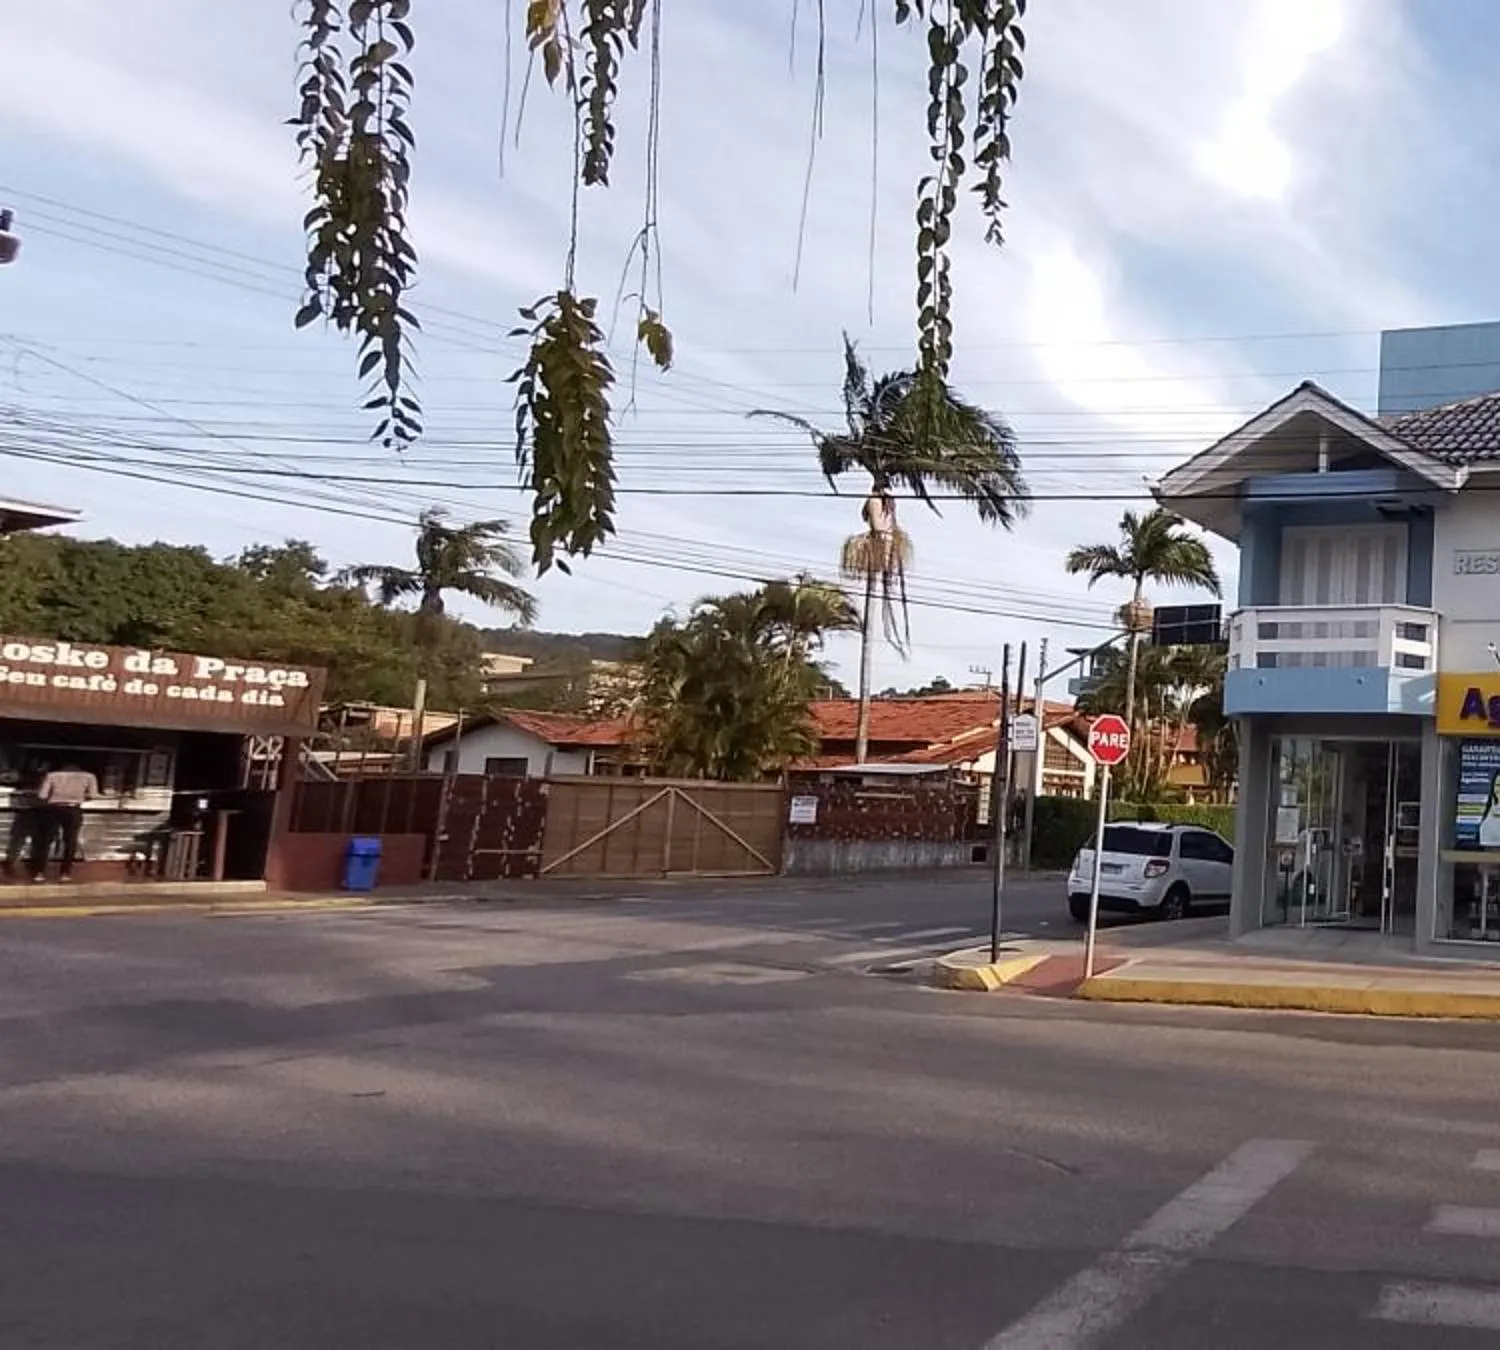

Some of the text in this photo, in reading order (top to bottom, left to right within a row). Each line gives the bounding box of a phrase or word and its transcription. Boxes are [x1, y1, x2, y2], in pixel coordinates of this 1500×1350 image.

[0, 641, 109, 669] oske
[193, 655, 309, 691] Praça
[53, 673, 117, 692] café
[124, 679, 159, 695] de
[166, 685, 234, 703] cada
[241, 689, 285, 706] dia
[1091, 731, 1128, 749] PARE
